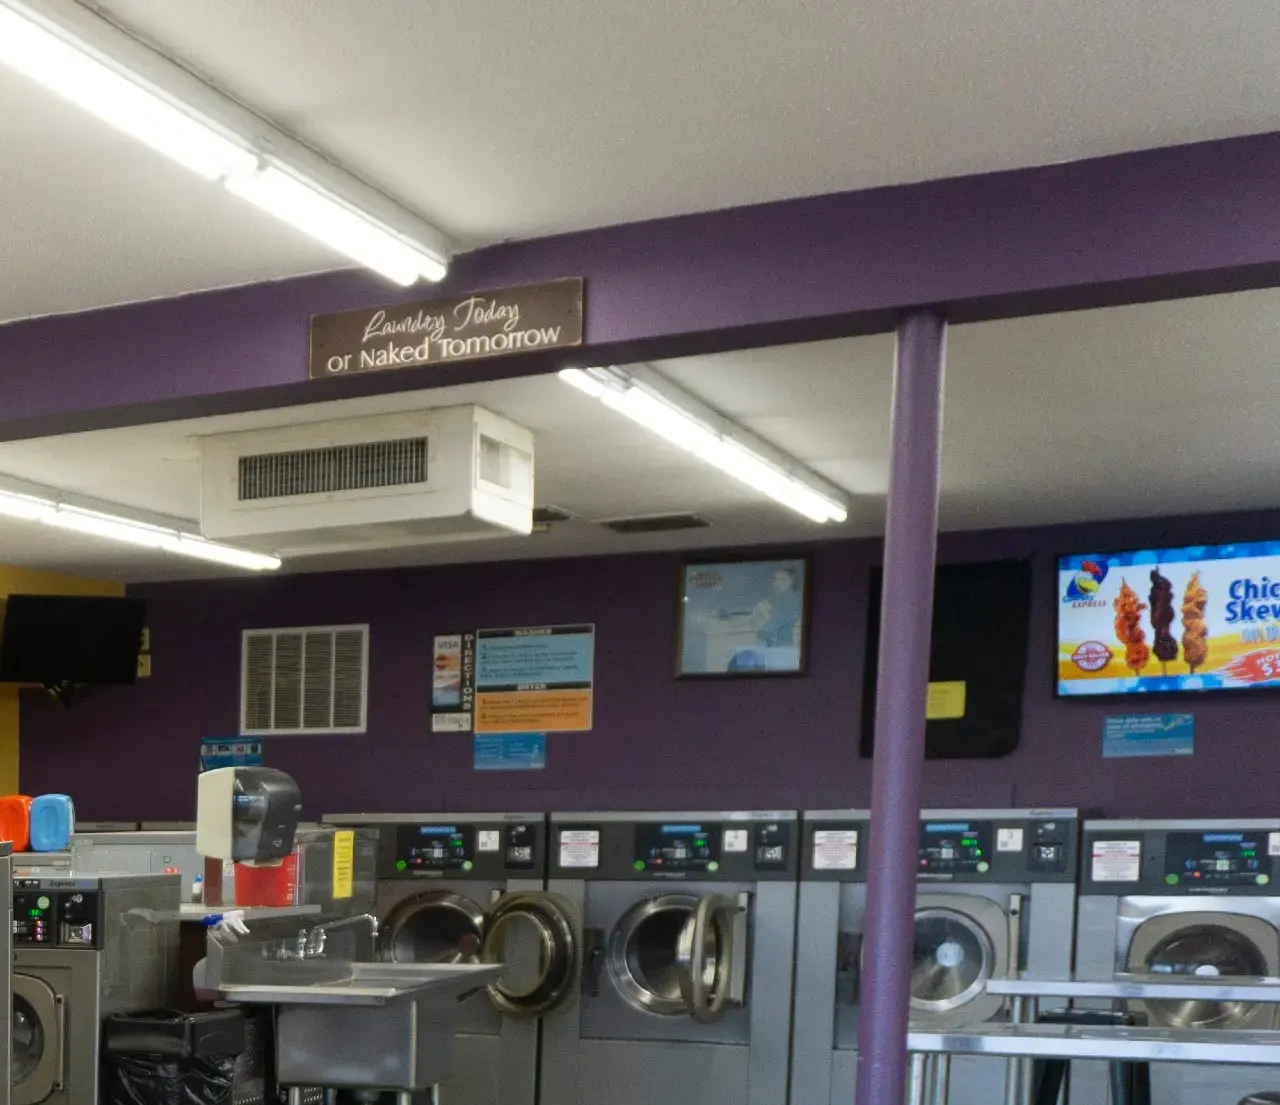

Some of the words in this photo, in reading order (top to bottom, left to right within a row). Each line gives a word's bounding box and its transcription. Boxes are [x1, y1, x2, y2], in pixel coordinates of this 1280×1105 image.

[362, 309, 447, 342] Laundry
[453, 296, 521, 331] Today
[327, 354, 352, 372] or
[360, 337, 429, 368] Naked
[439, 325, 562, 357] Tomorrow
[1229, 576, 1280, 601] Chic
